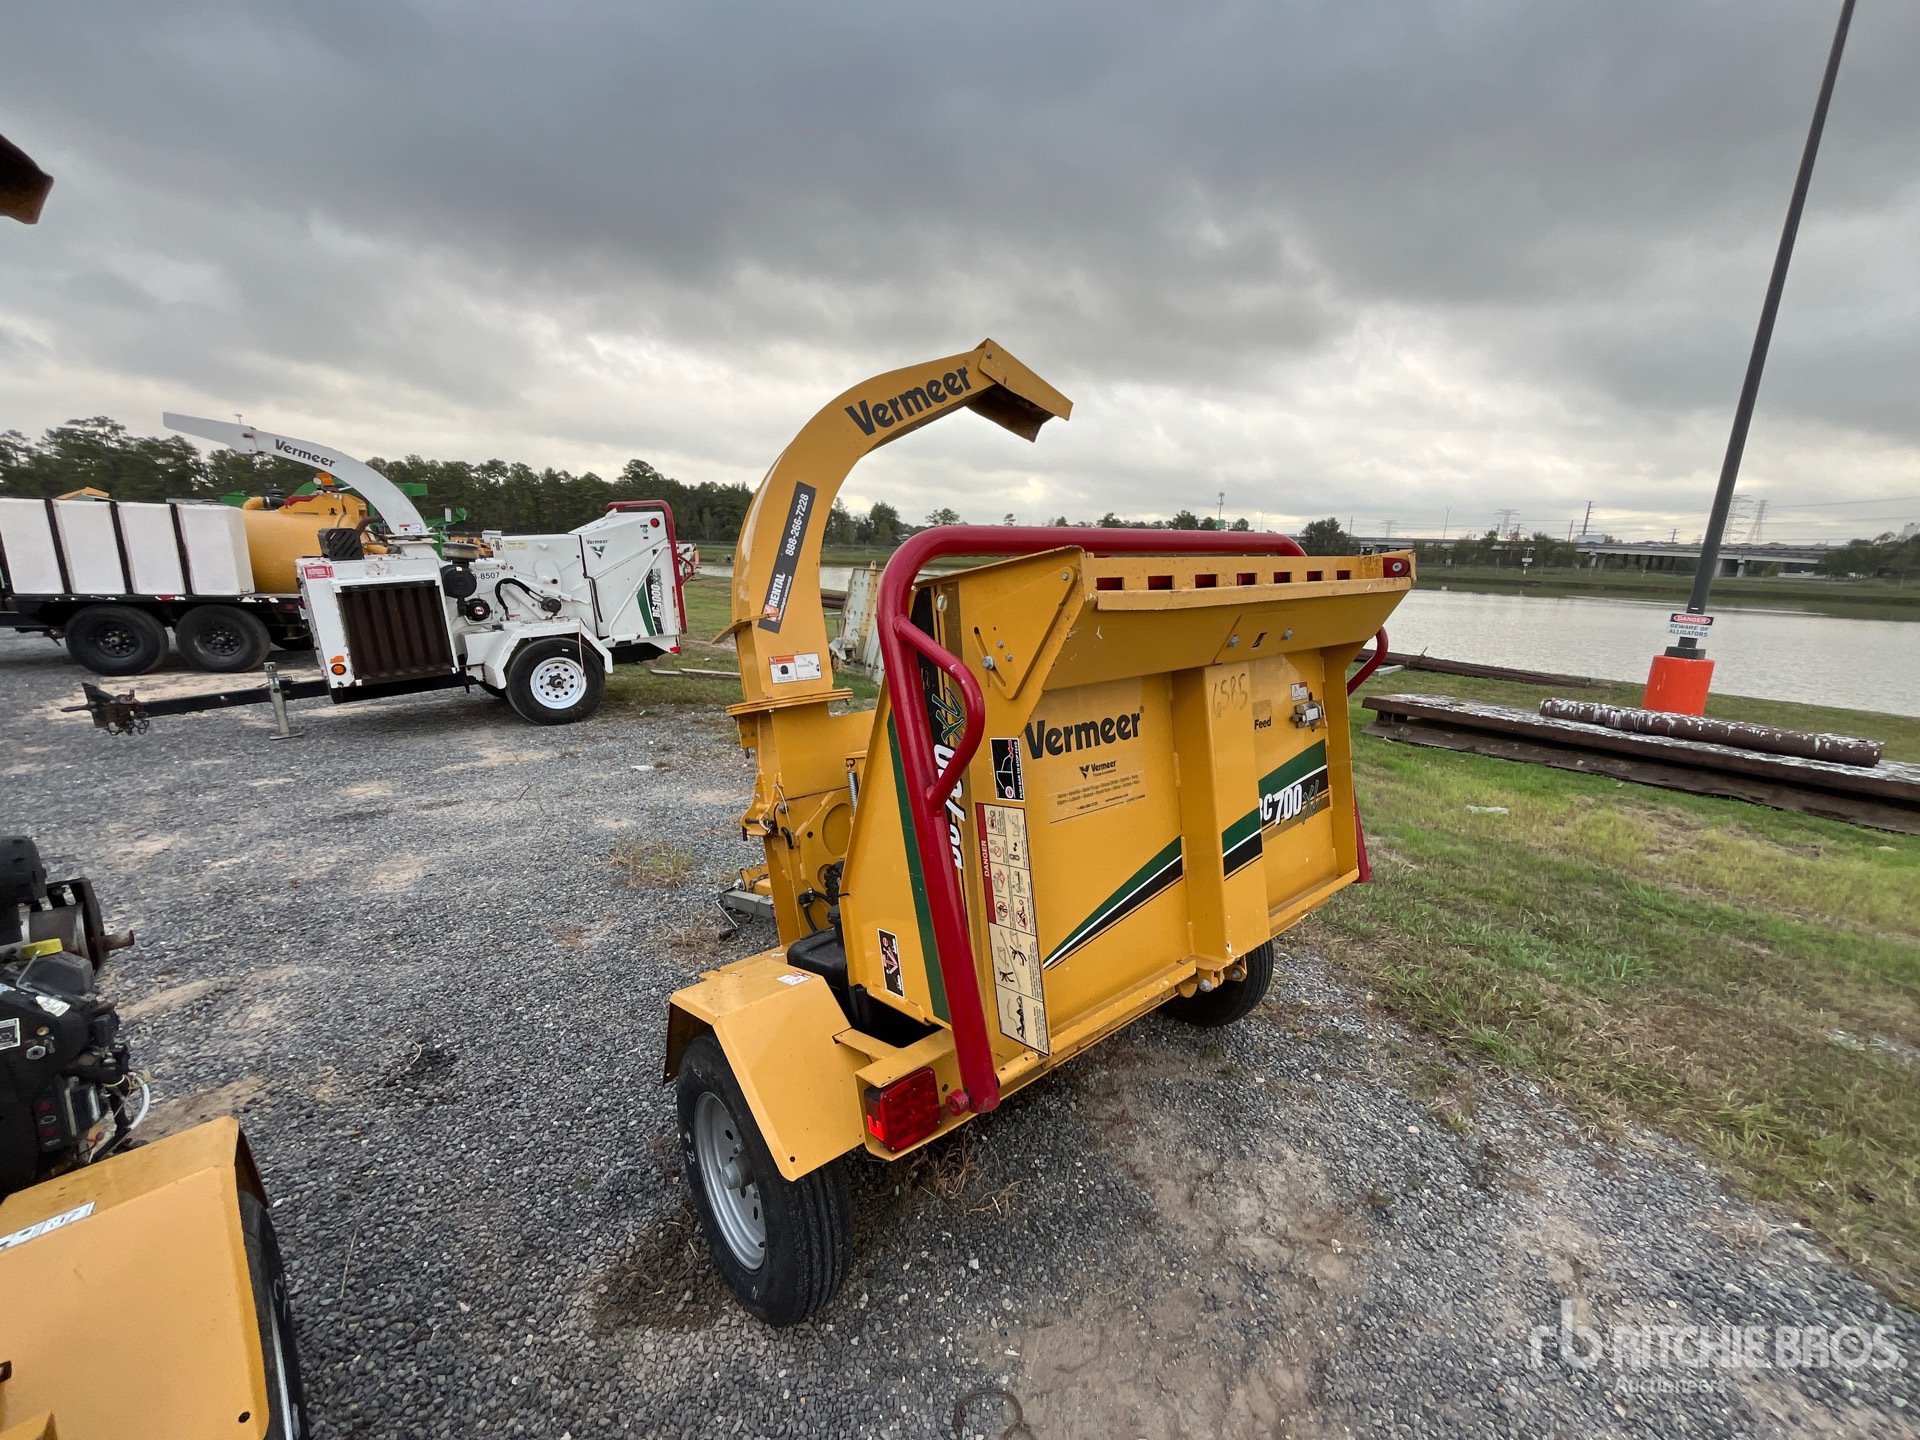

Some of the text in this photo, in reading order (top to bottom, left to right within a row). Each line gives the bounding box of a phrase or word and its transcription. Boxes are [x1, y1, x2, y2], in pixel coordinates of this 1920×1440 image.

[843, 366, 972, 437] Vermeer
[274, 438, 336, 468] Vermeer
[784, 492, 809, 557] 888-266-7228
[768, 572, 786, 608] RENTAL
[1668, 628, 1708, 638] ALLIGATORS
[1669, 623, 1698, 631] BEWARE
[1677, 615, 1707, 625] DANGER
[1024, 712, 1141, 760] Vermeer
[1254, 716, 1272, 731] Feed
[1091, 760, 1117, 772] Vermeer
[980, 840, 991, 877] DANGER
